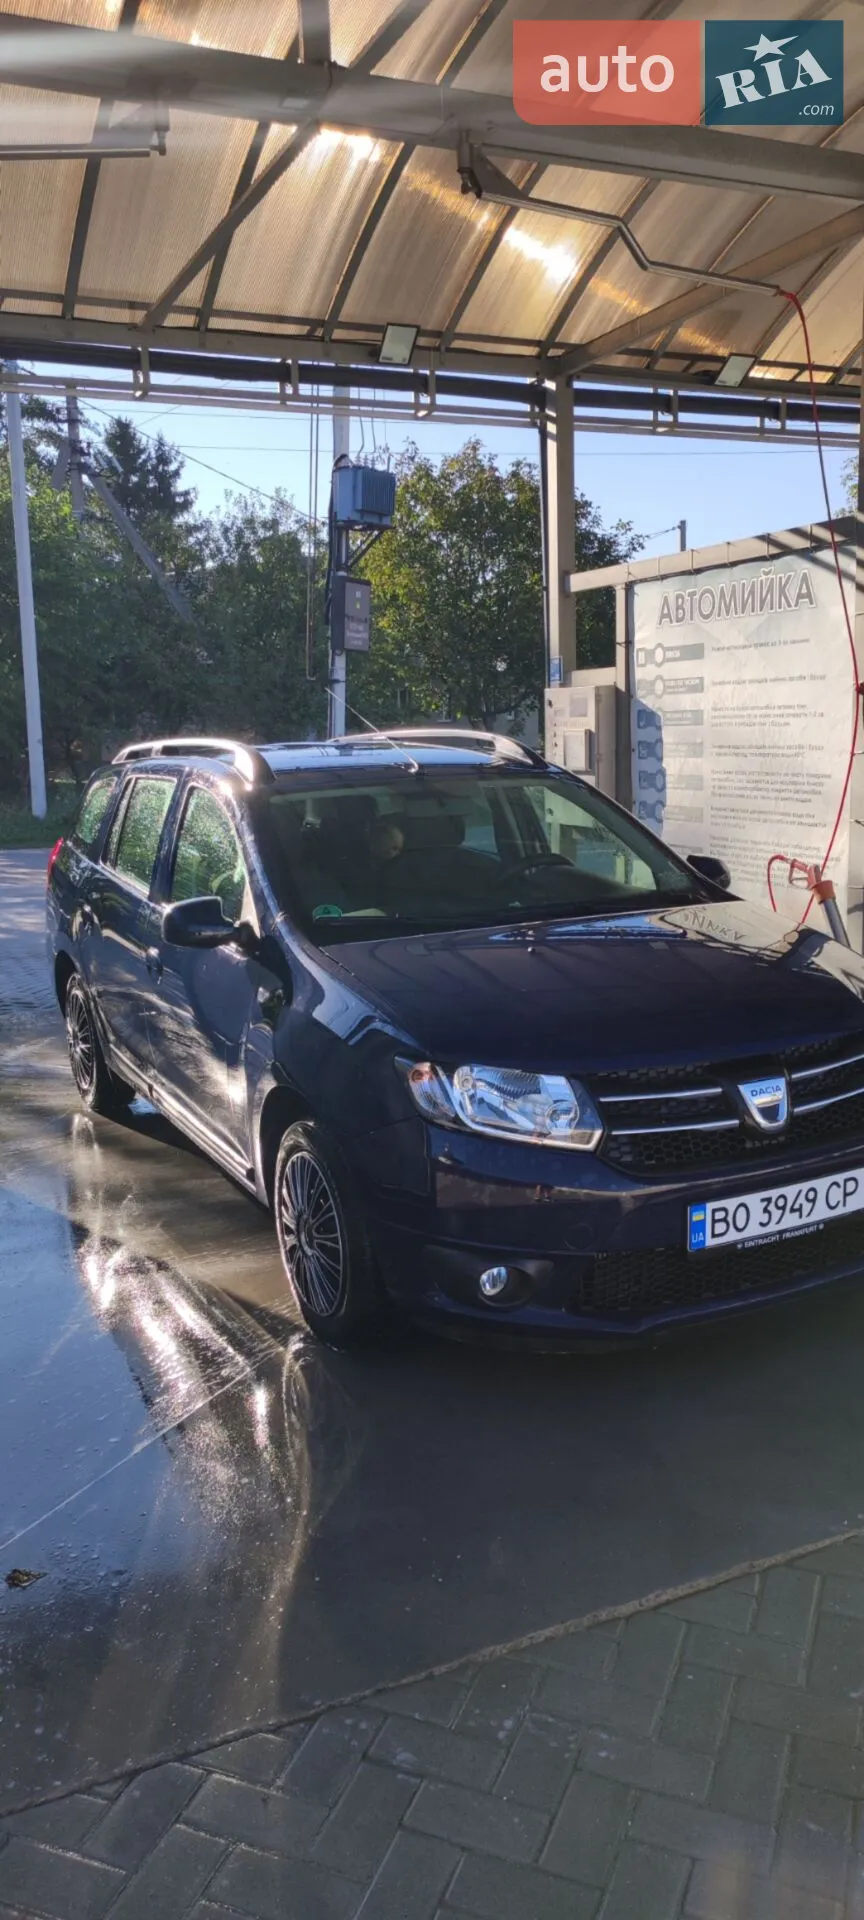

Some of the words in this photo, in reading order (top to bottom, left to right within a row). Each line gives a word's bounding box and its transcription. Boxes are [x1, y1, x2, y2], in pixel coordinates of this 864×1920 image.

[658, 567, 815, 627] АВТОМИЙКА
[750, 1084, 782, 1098] DACIA
[711, 1202, 750, 1239] BO
[758, 1187, 818, 1228] 3949
[825, 1176, 859, 1210] CP
[691, 1230, 705, 1244] UA
[744, 1234, 780, 1248] EINTRACHT
[782, 1224, 818, 1240] FRANKFURT
